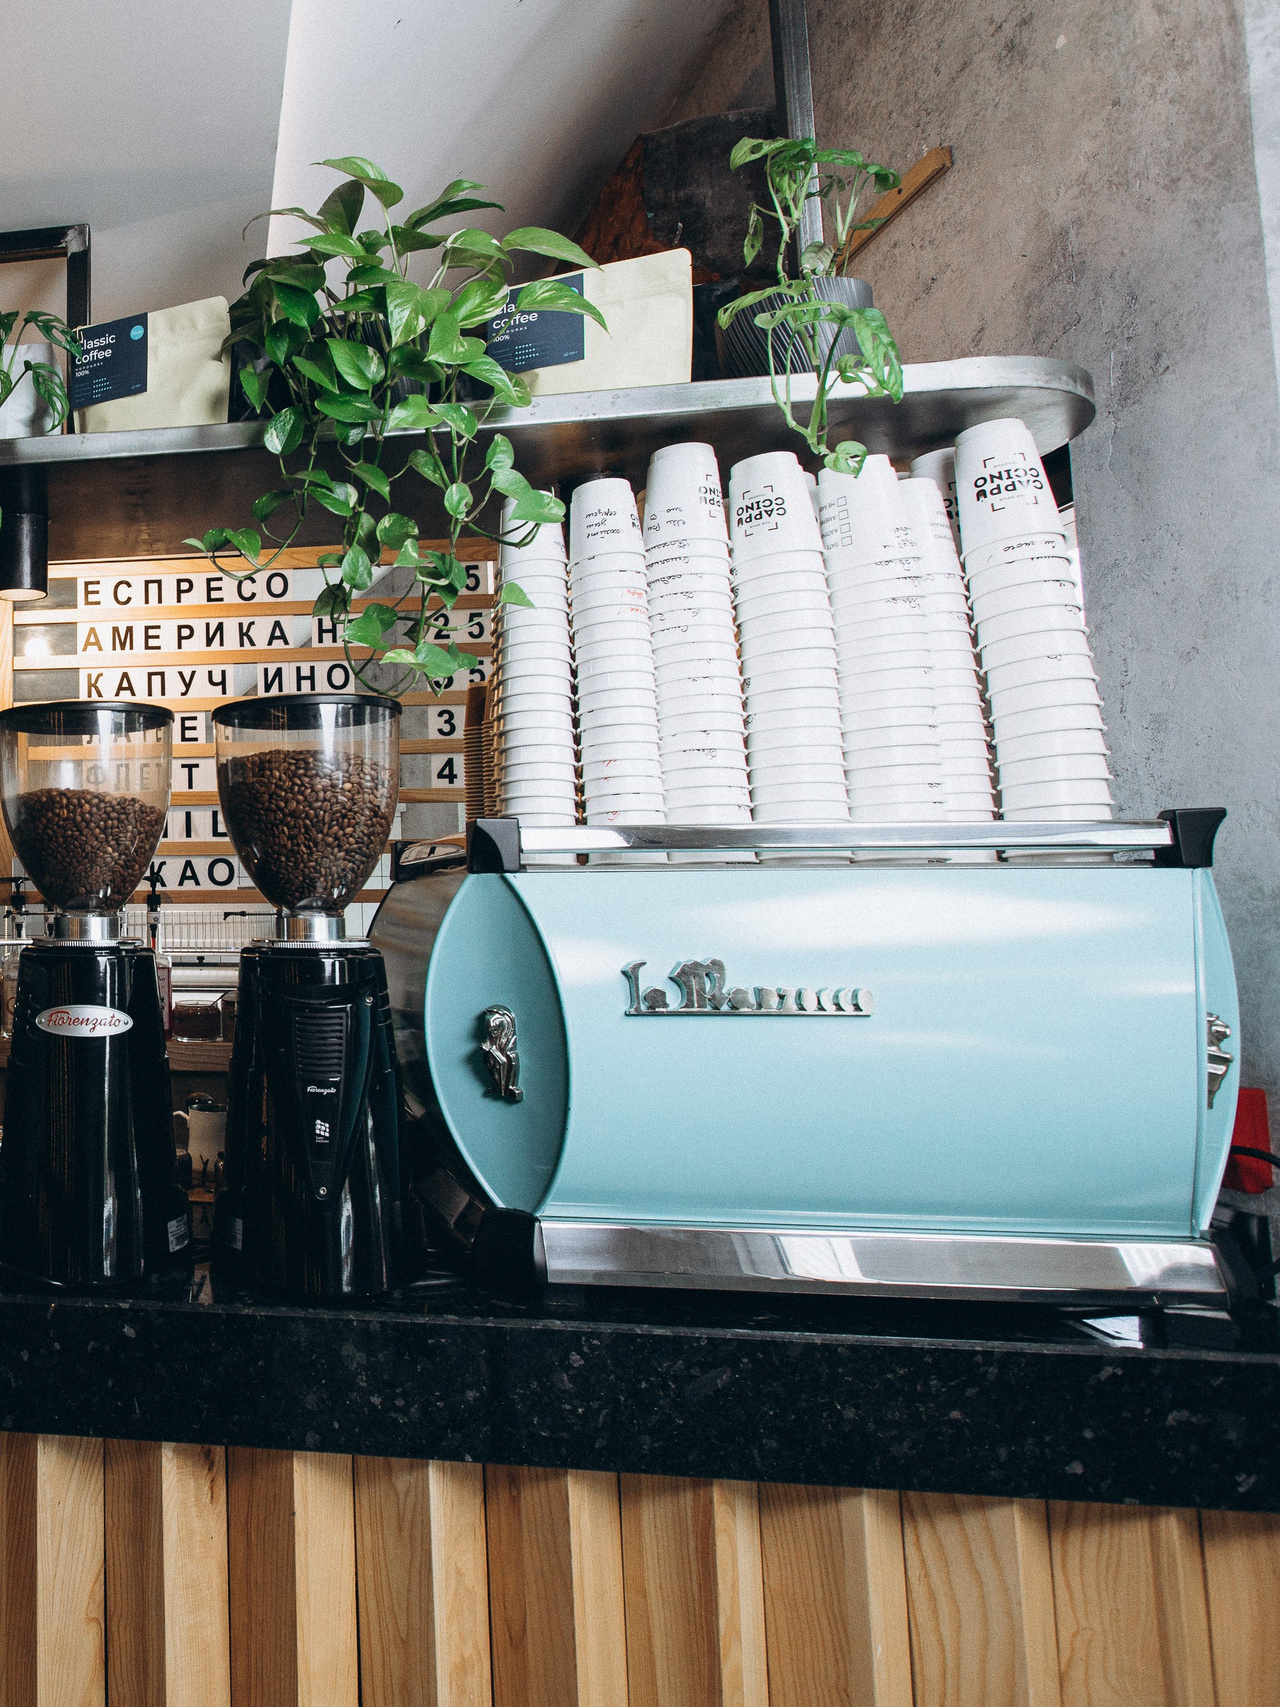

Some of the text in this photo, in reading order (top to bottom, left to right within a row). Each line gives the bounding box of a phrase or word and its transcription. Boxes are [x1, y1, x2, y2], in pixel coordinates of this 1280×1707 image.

[81, 334, 116, 350] lassic
[75, 369, 90, 378] 100%
[973, 467, 1040, 488] CCINO
[975, 480, 1044, 502] CAPPU
[736, 496, 785, 517] CCINO
[737, 507, 787, 528] CAPPU
[83, 572, 289, 606] ЕСПРЕСО
[46, 1010, 122, 1034] Fiorenzato
